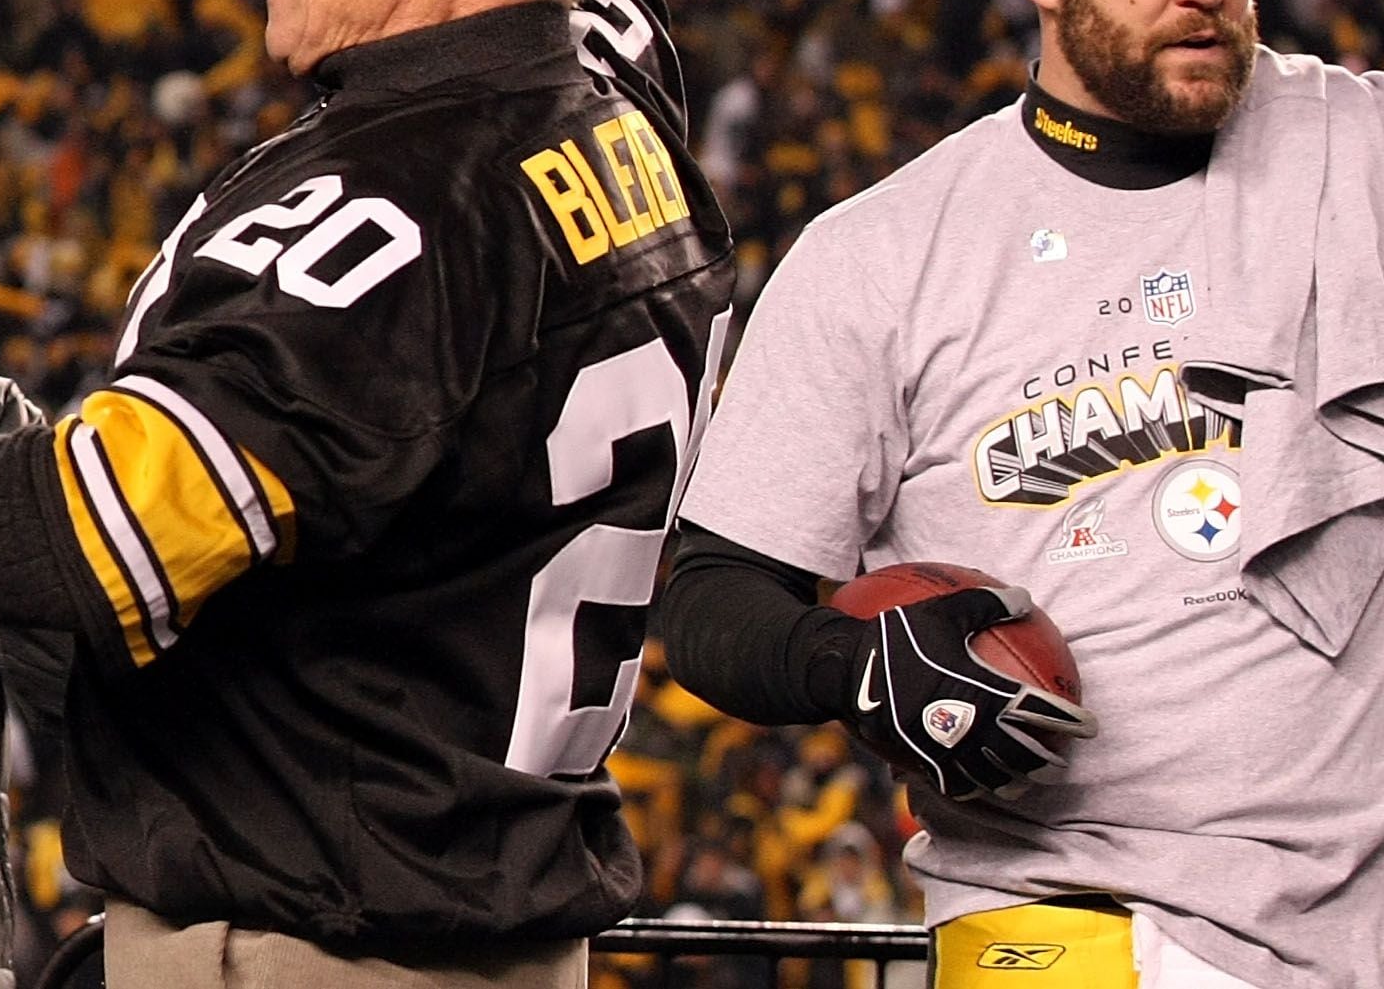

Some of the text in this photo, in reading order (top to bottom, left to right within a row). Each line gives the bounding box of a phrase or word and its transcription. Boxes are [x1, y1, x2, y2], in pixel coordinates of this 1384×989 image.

[1034, 107, 1099, 150] Steelers
[192, 174, 422, 309] 20
[1097, 297, 1134, 315] 20
[1150, 293, 1190, 319] NFL
[1167, 505, 1201, 518] Steelers
[1048, 542, 1125, 563] CHAMPIONS
[1183, 587, 1248, 606] Reebok
